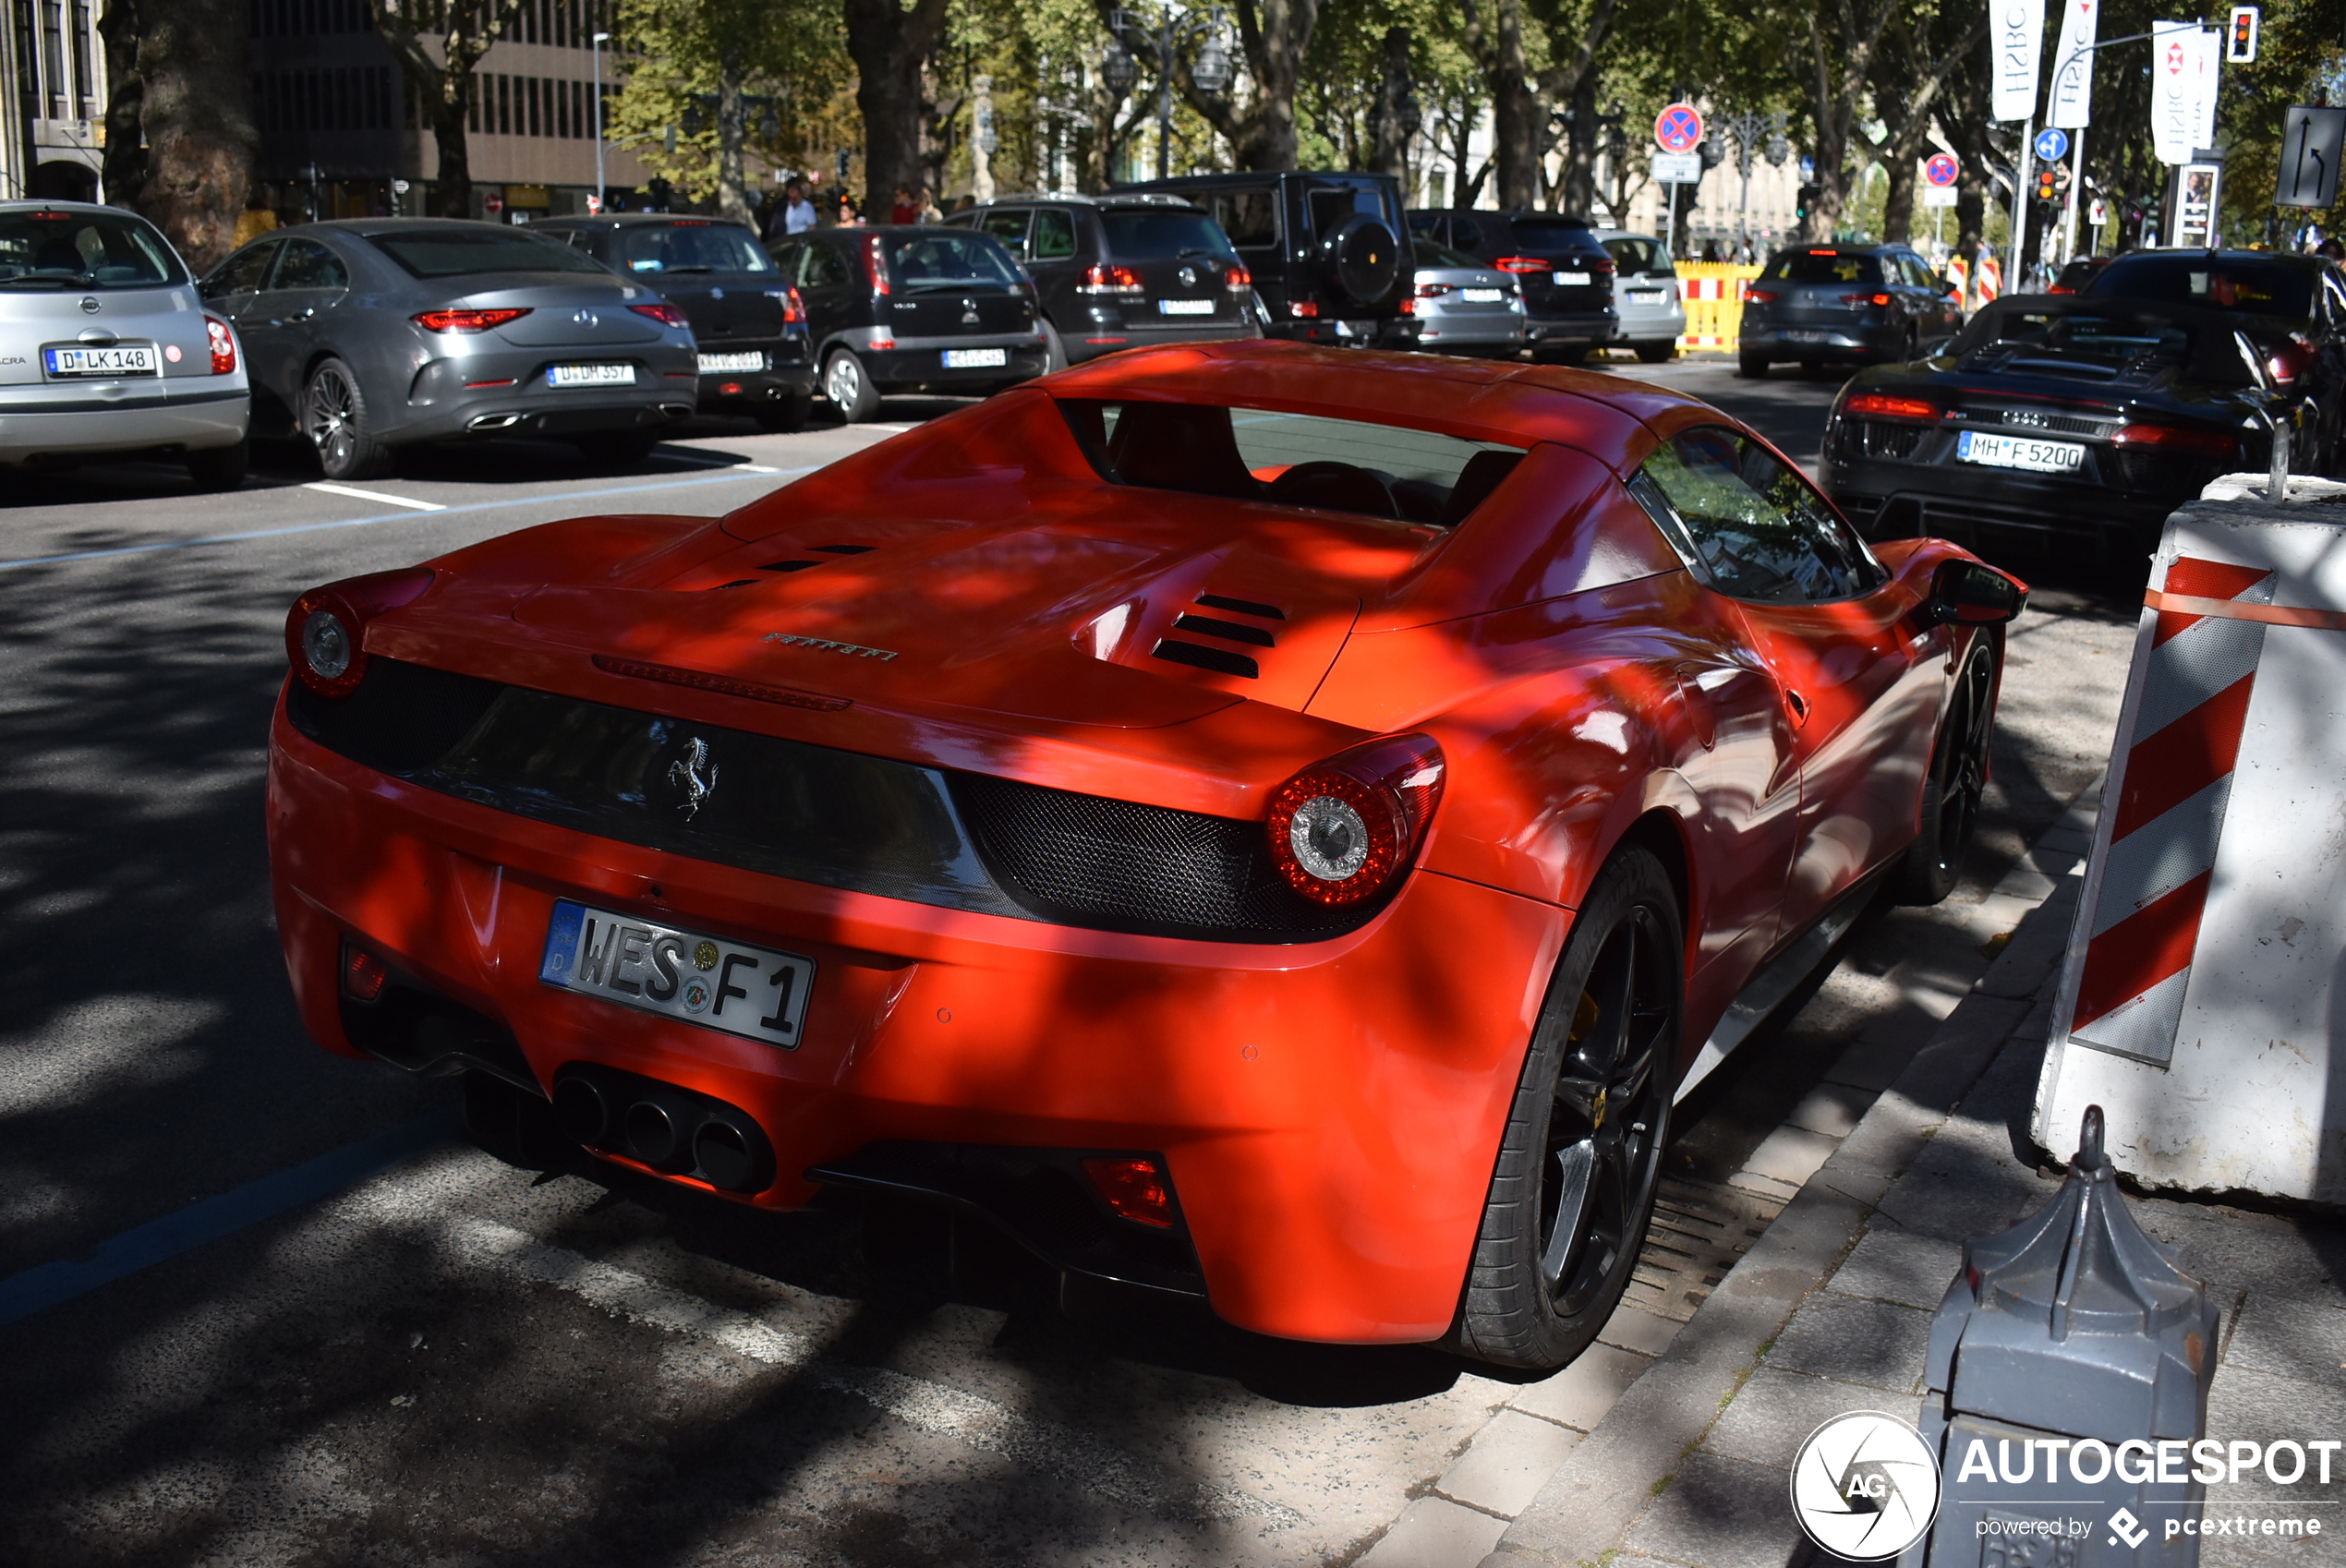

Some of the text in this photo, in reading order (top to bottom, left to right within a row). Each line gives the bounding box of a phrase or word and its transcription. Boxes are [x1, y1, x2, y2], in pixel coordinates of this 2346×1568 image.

[0, 356, 27, 366] CRA
[63, 350, 146, 368] D LK 148
[1973, 438, 2000, 457] MH
[2012, 442, 2026, 460] F
[2028, 444, 2079, 467] 5200
[579, 918, 685, 1002] WES
